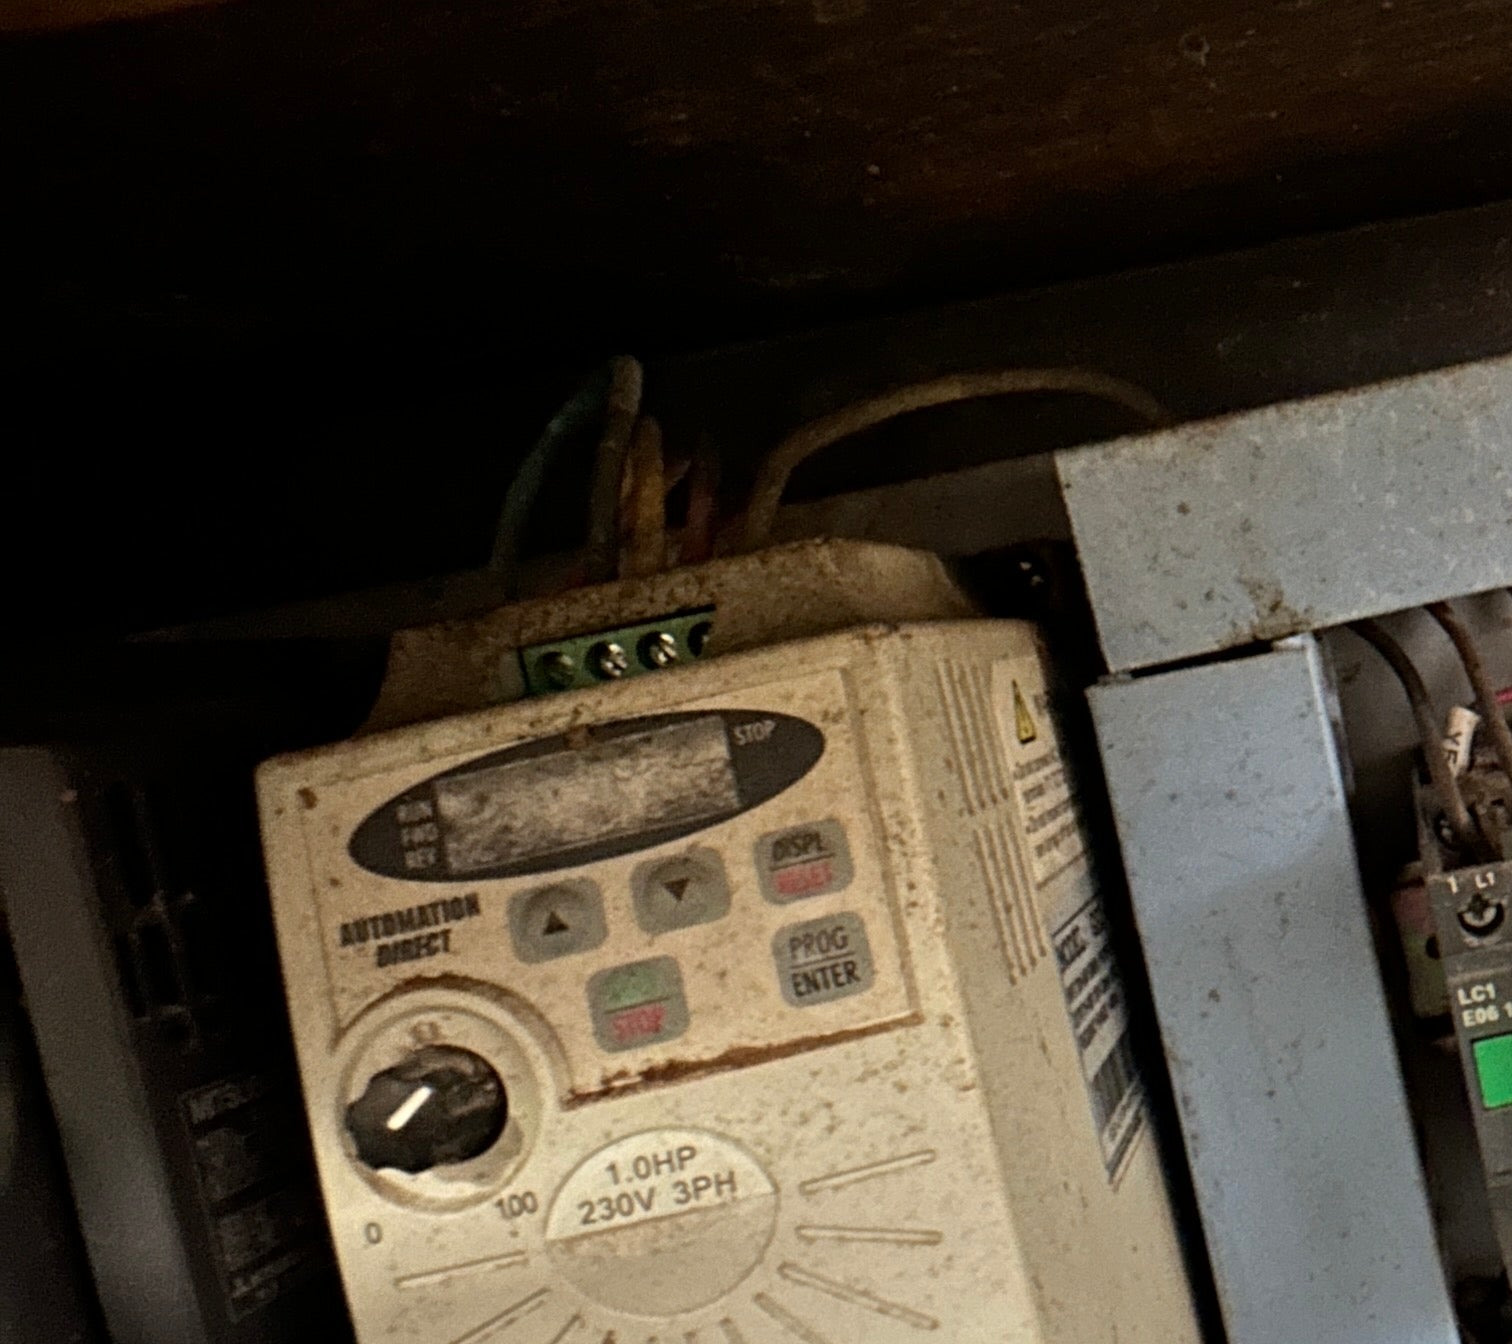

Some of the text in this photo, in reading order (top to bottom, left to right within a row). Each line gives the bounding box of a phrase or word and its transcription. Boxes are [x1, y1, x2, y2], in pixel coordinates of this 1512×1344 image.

[733, 719, 777, 747] STOP
[1447, 872, 1495, 894] 1 L1
[340, 892, 481, 947] AUTOMATION
[376, 929, 451, 968] DIRECT
[789, 926, 849, 959] PROG
[792, 960, 861, 998] ENTER
[1457, 982, 1496, 1006] LC1
[605, 1145, 698, 1187] 1.0HP
[497, 1190, 539, 1220] 100
[577, 1170, 739, 1226] 230V 3PH
[364, 1221, 383, 1245] 0
